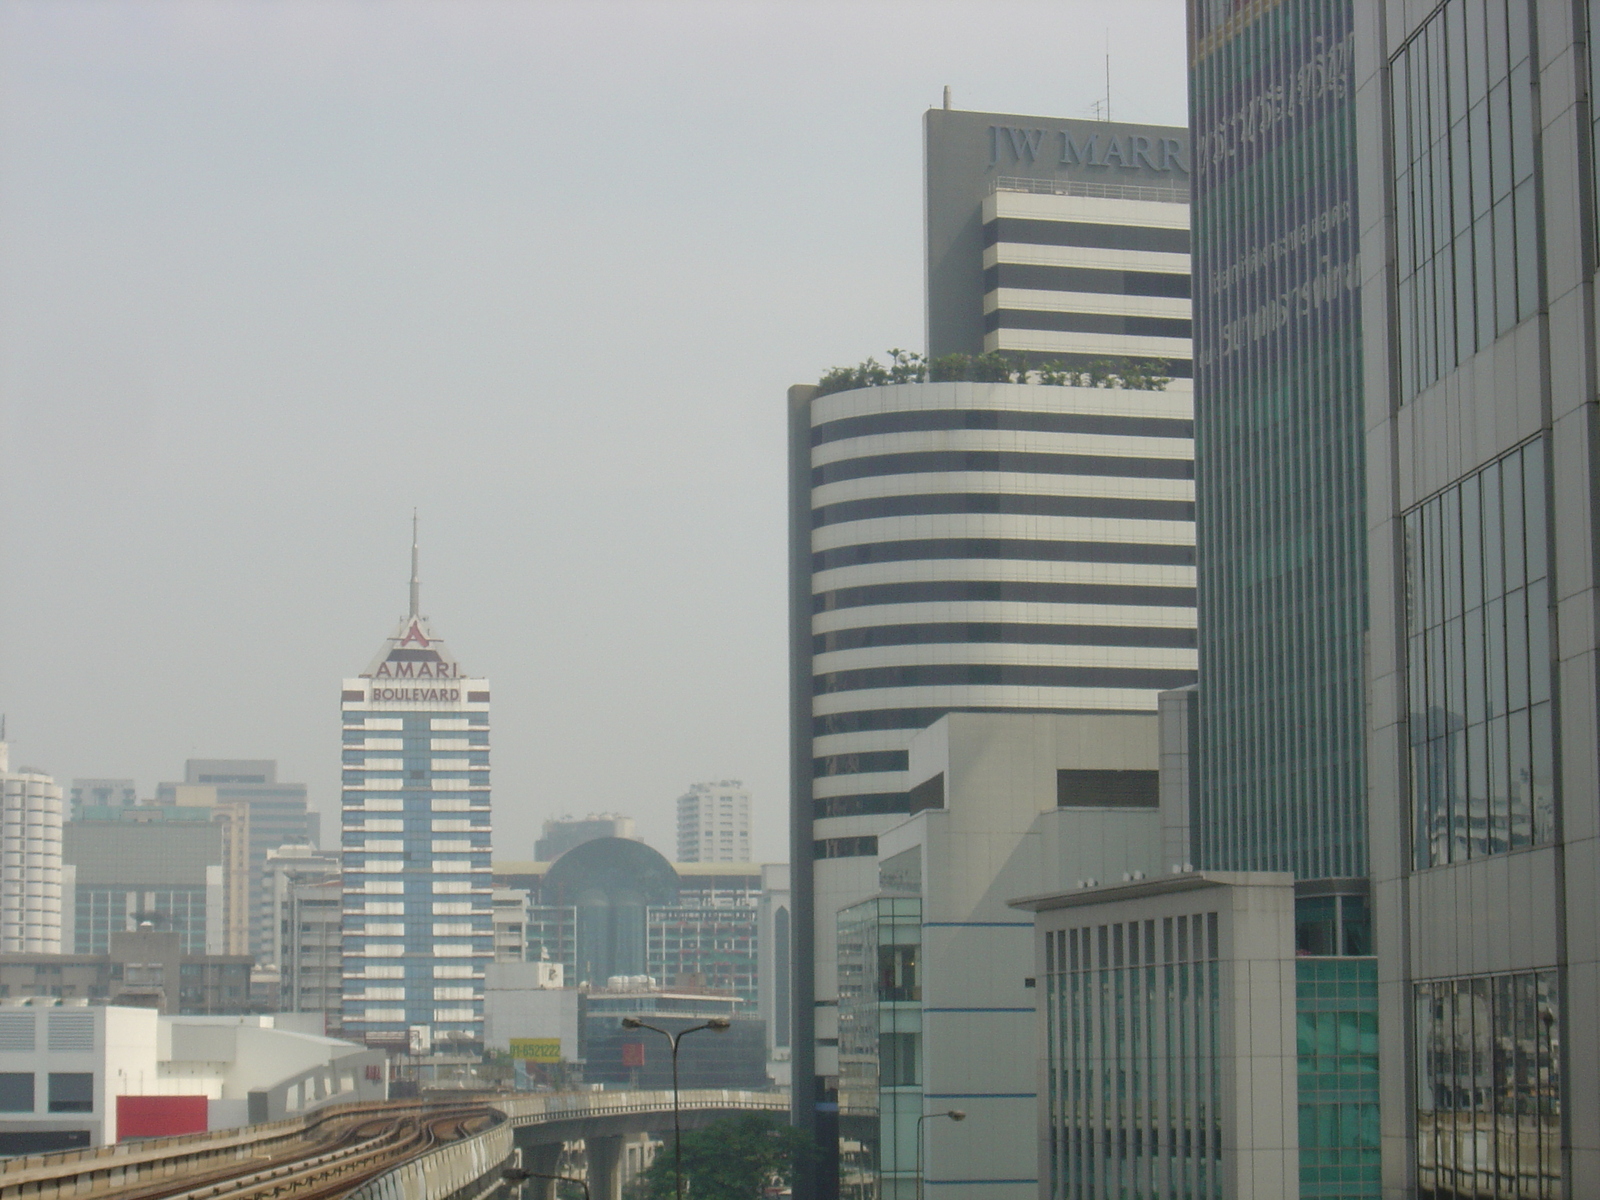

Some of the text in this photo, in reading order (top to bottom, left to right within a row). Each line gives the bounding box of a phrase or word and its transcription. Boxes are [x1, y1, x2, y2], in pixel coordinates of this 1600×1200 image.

[986, 125, 1047, 168] JW
[375, 662, 457, 678] AMARI
[373, 688, 459, 701] BOULEVARD
